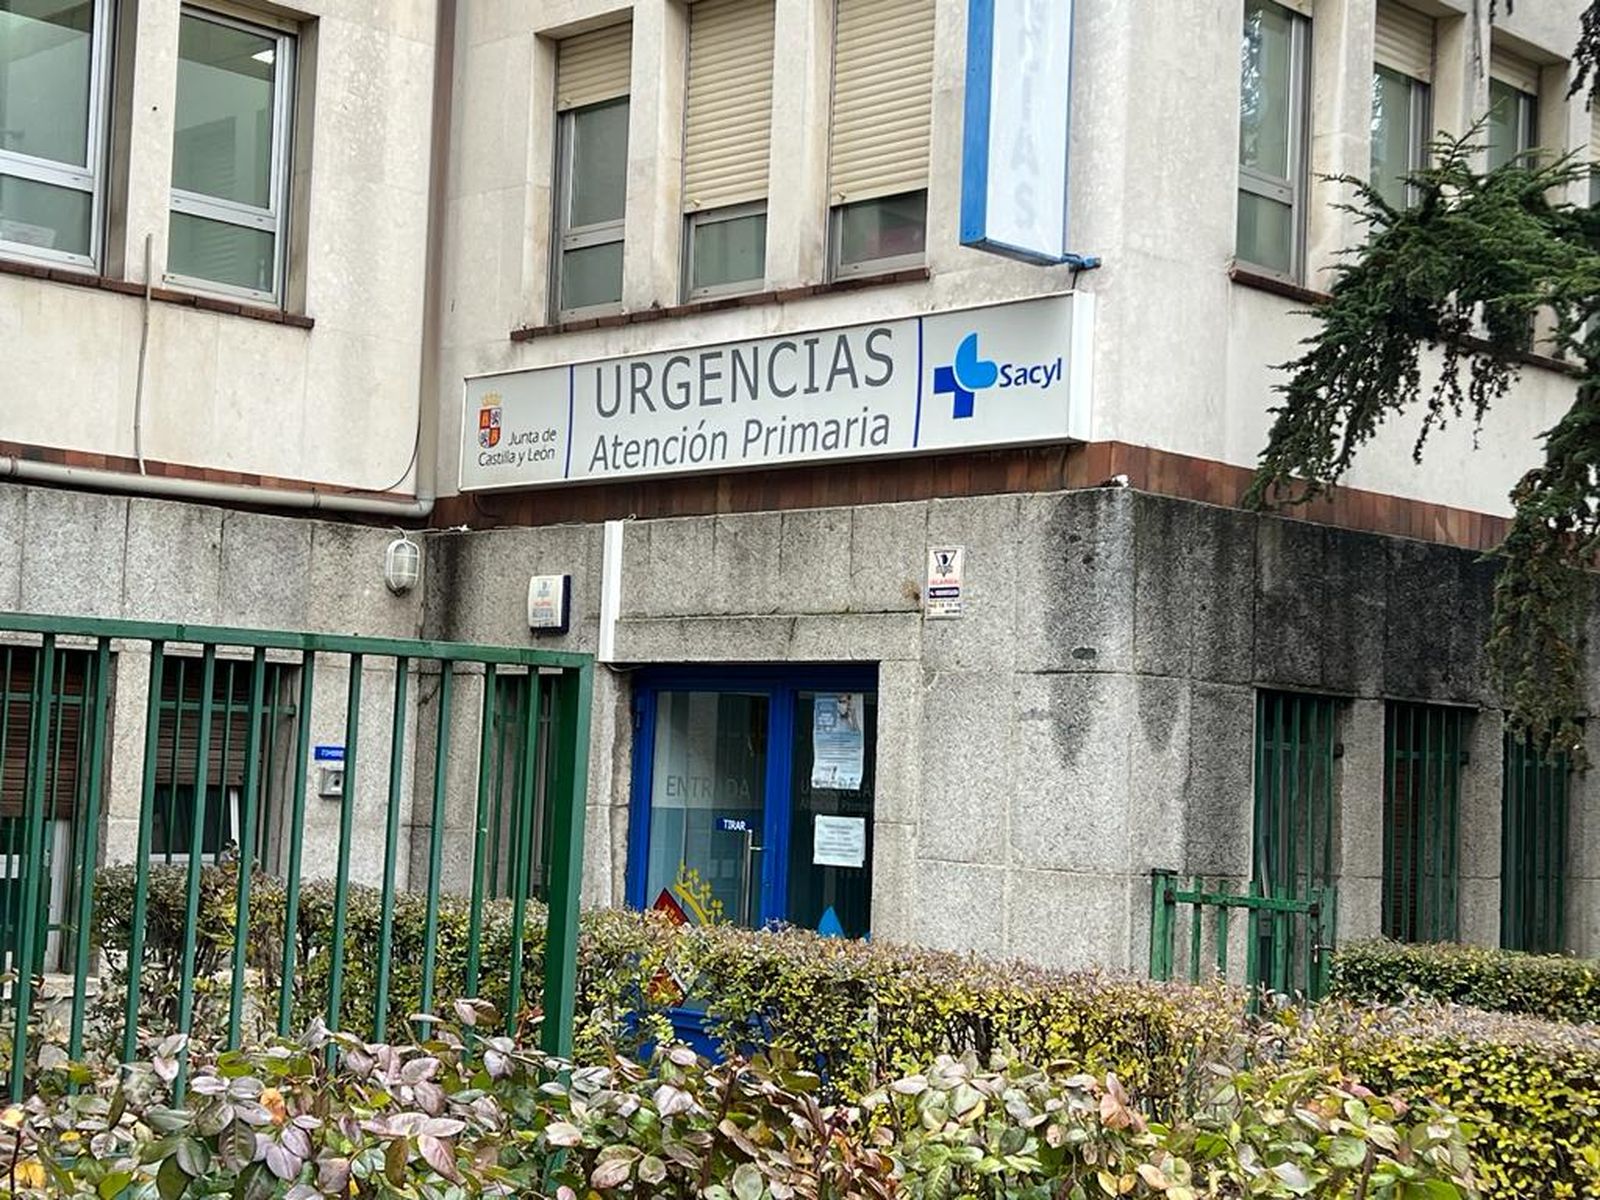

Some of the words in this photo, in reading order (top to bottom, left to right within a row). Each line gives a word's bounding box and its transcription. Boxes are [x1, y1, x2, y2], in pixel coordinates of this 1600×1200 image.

[596, 328, 894, 418] URGENCIAS
[999, 356, 1063, 389] Sacyl
[508, 431, 540, 446] Junta
[541, 427, 557, 442] de
[589, 419, 728, 473] Atención
[742, 406, 890, 459] Primaria
[478, 451, 516, 467] Castilla
[516, 451, 526, 467] y
[724, 819, 746, 831] TIRAR
